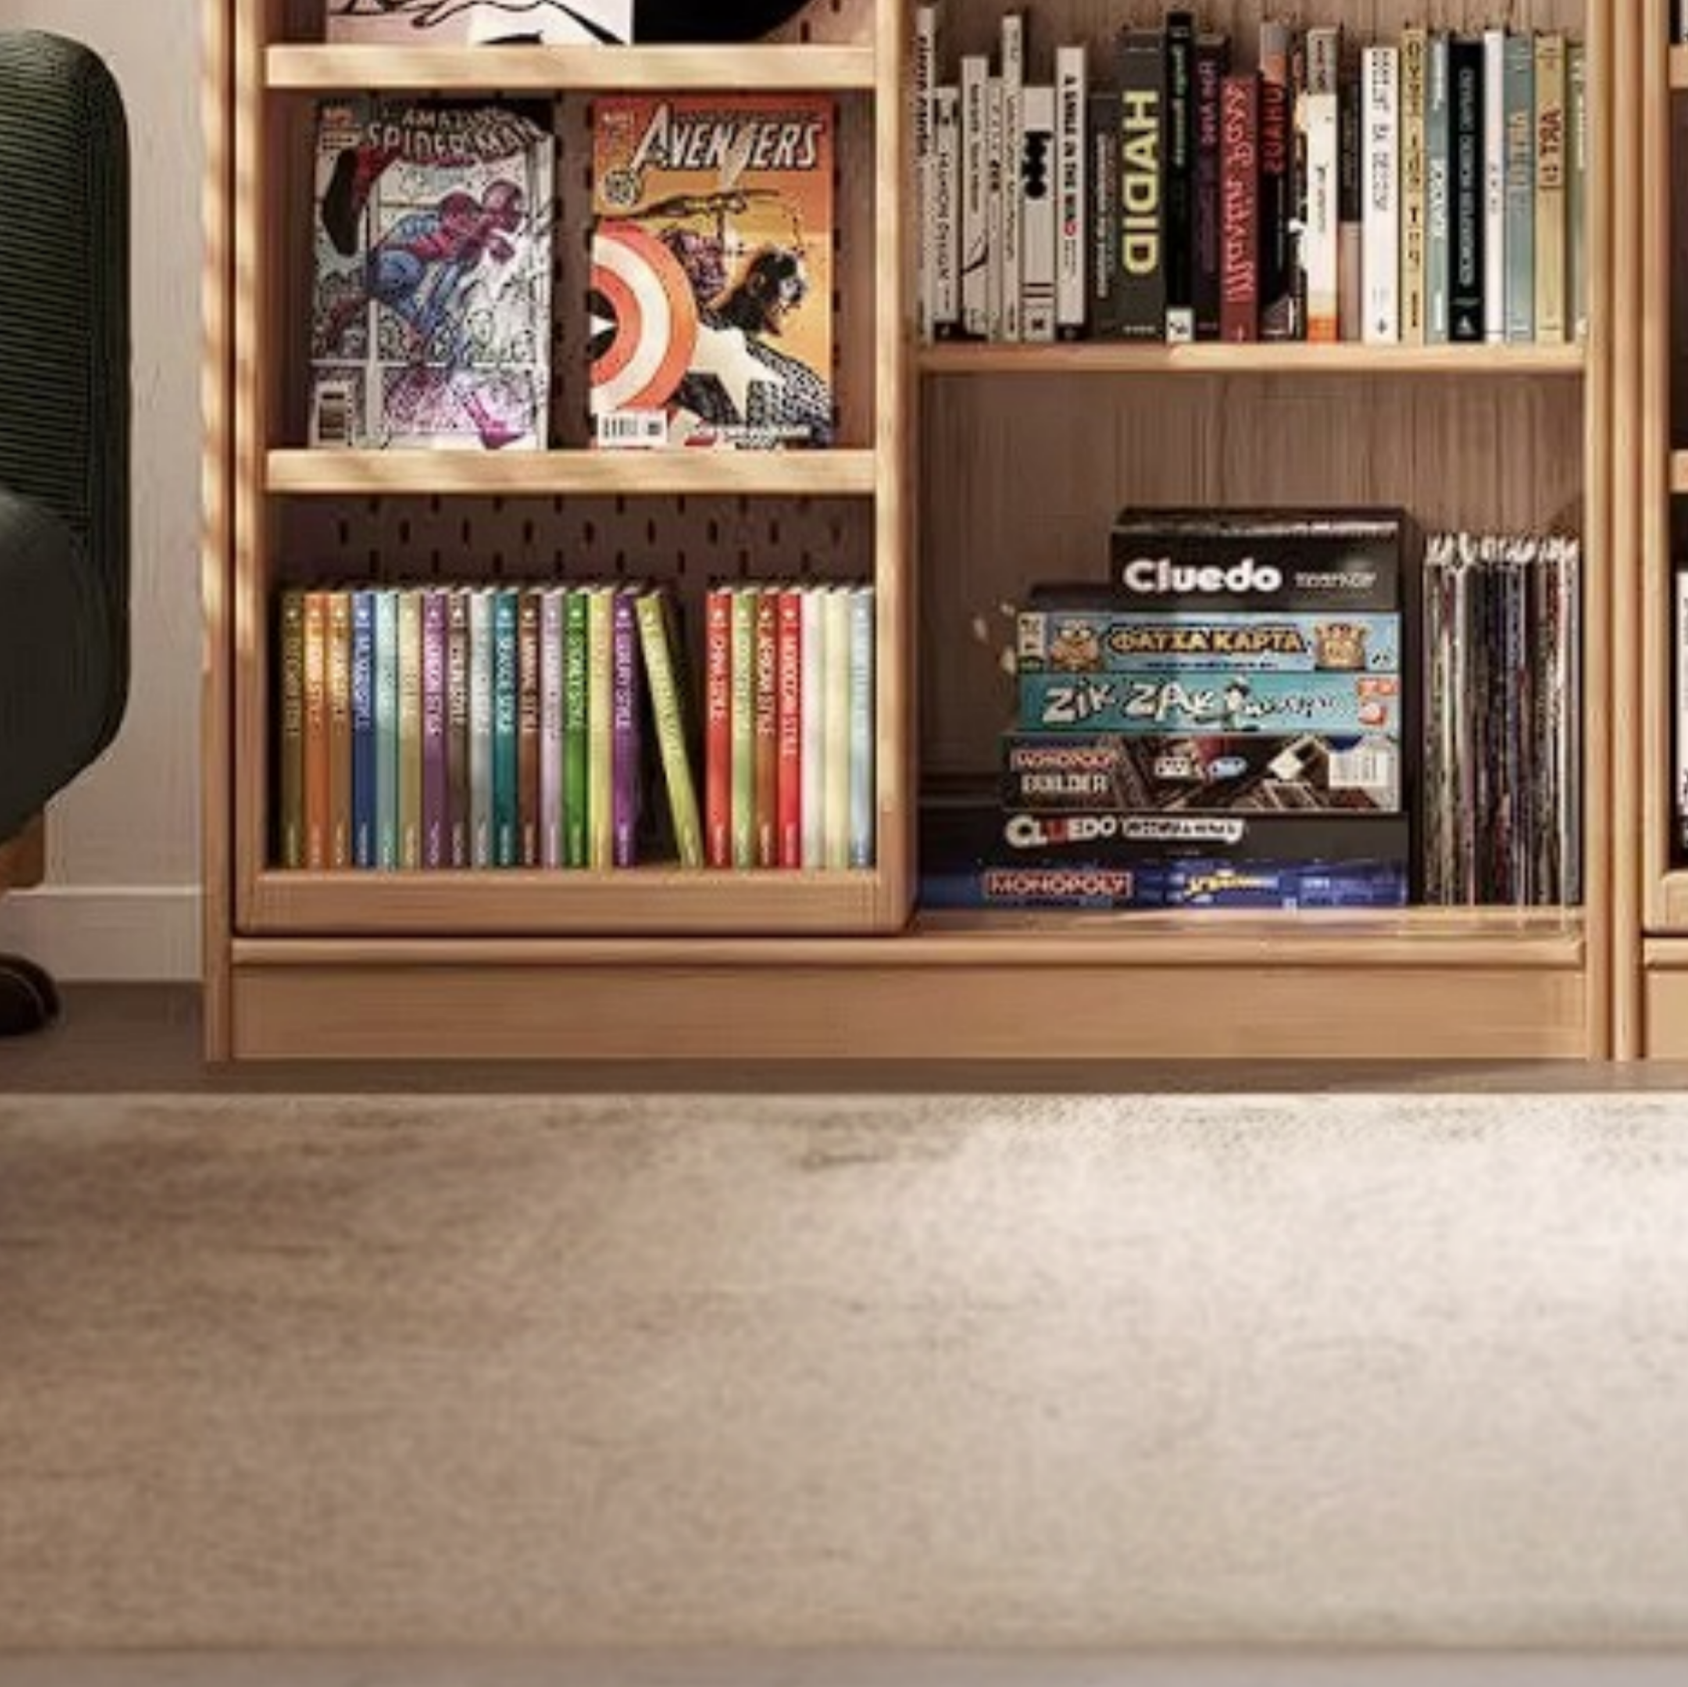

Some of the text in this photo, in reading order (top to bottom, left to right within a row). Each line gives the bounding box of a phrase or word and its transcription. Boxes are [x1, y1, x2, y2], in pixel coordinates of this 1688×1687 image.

[1064, 142, 1077, 158] IN
[1064, 163, 1077, 189] THE
[1122, 557, 1283, 593] Cluedo
[1013, 750, 1114, 770] MONOPOLY
[1022, 774, 1109, 793] BUILDER
[1005, 815, 1117, 848] CLUEDO
[989, 873, 1126, 895] MONOPOLY
